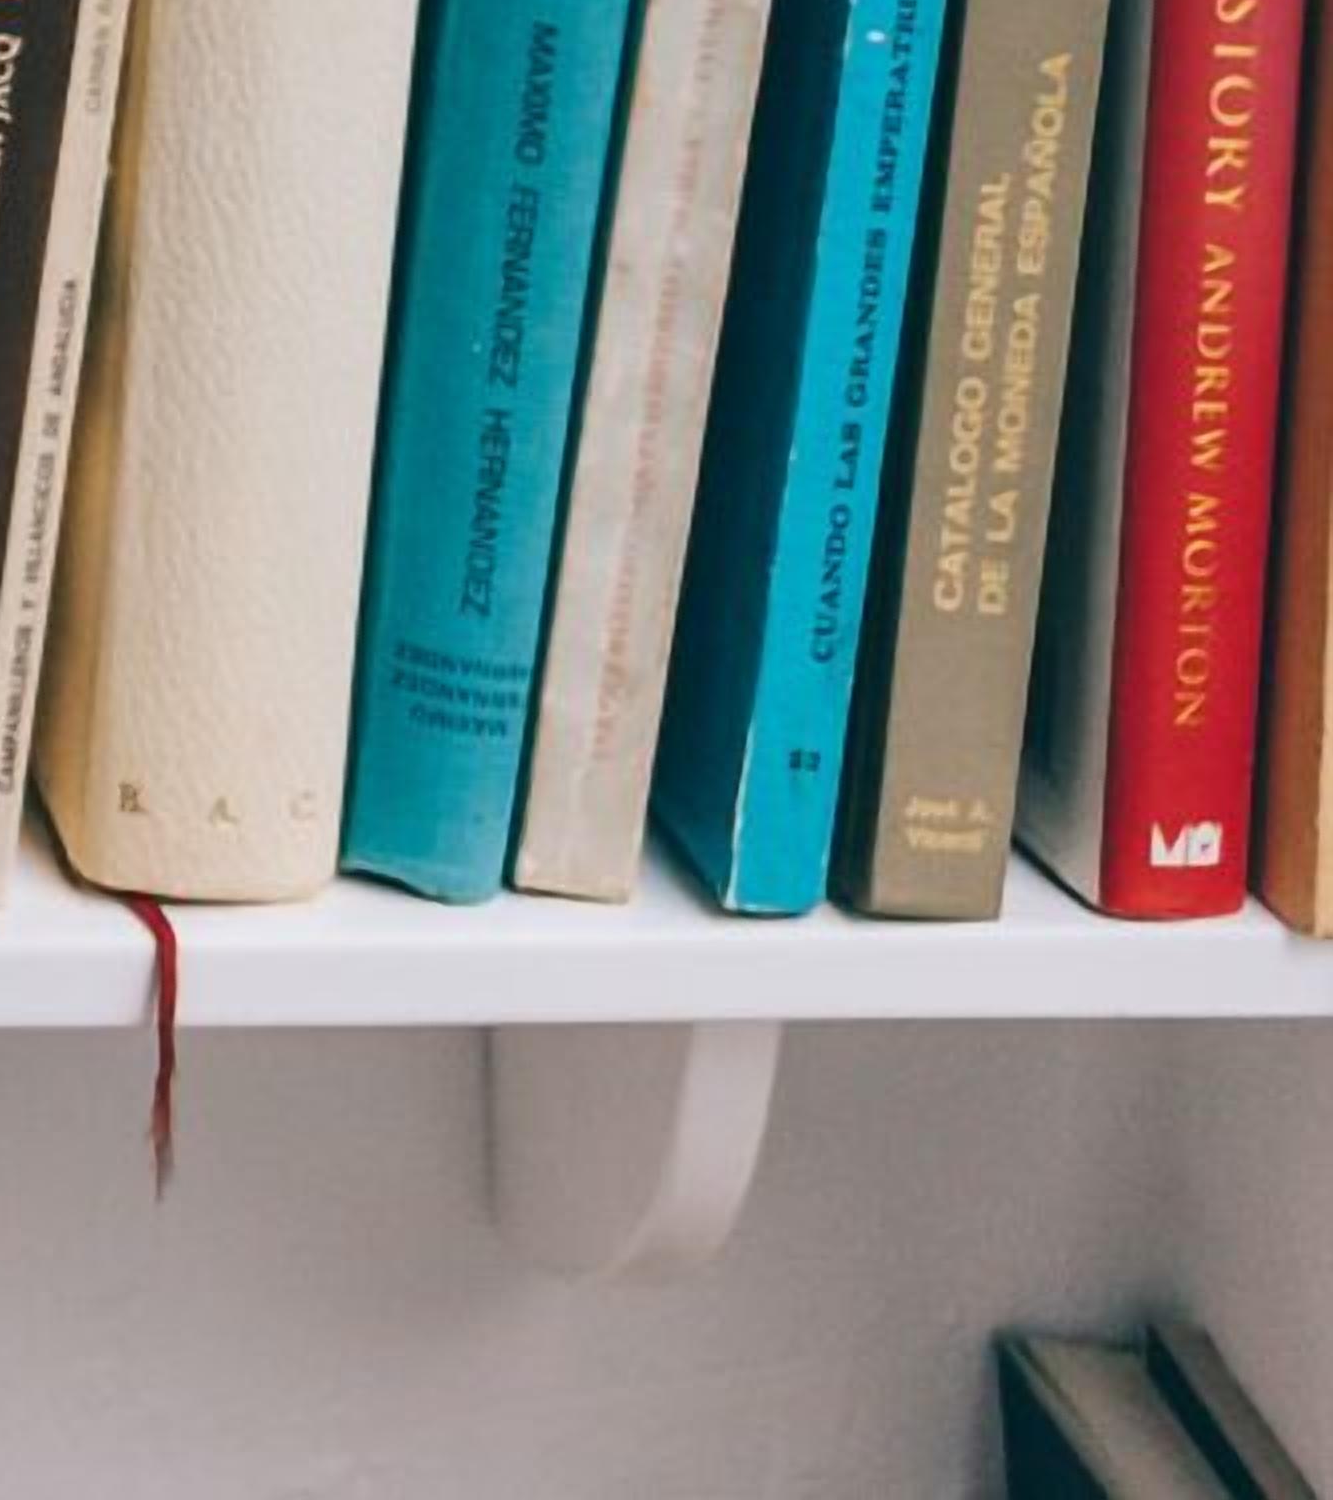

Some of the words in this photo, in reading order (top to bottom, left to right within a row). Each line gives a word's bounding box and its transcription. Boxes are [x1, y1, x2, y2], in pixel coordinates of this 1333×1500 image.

[514, 21, 558, 165] MAXIMO
[989, 54, 1071, 275] ESPAÑOLA
[488, 183, 540, 387] FERNANDEZ
[845, 228, 887, 408] GRANDES
[1192, 244, 1234, 468] ANDREW
[834, 422, 861, 490] LAS
[934, 377, 987, 611] CATALOGO
[961, 173, 1030, 361] GENERAL
[992, 293, 1040, 473] MONEDA
[459, 408, 511, 617] HERNANDEZ
[812, 504, 850, 663] CUANDO
[977, 560, 1008, 614] DE
[985, 491, 1018, 542] LA
[1175, 493, 1219, 724] MORTON
